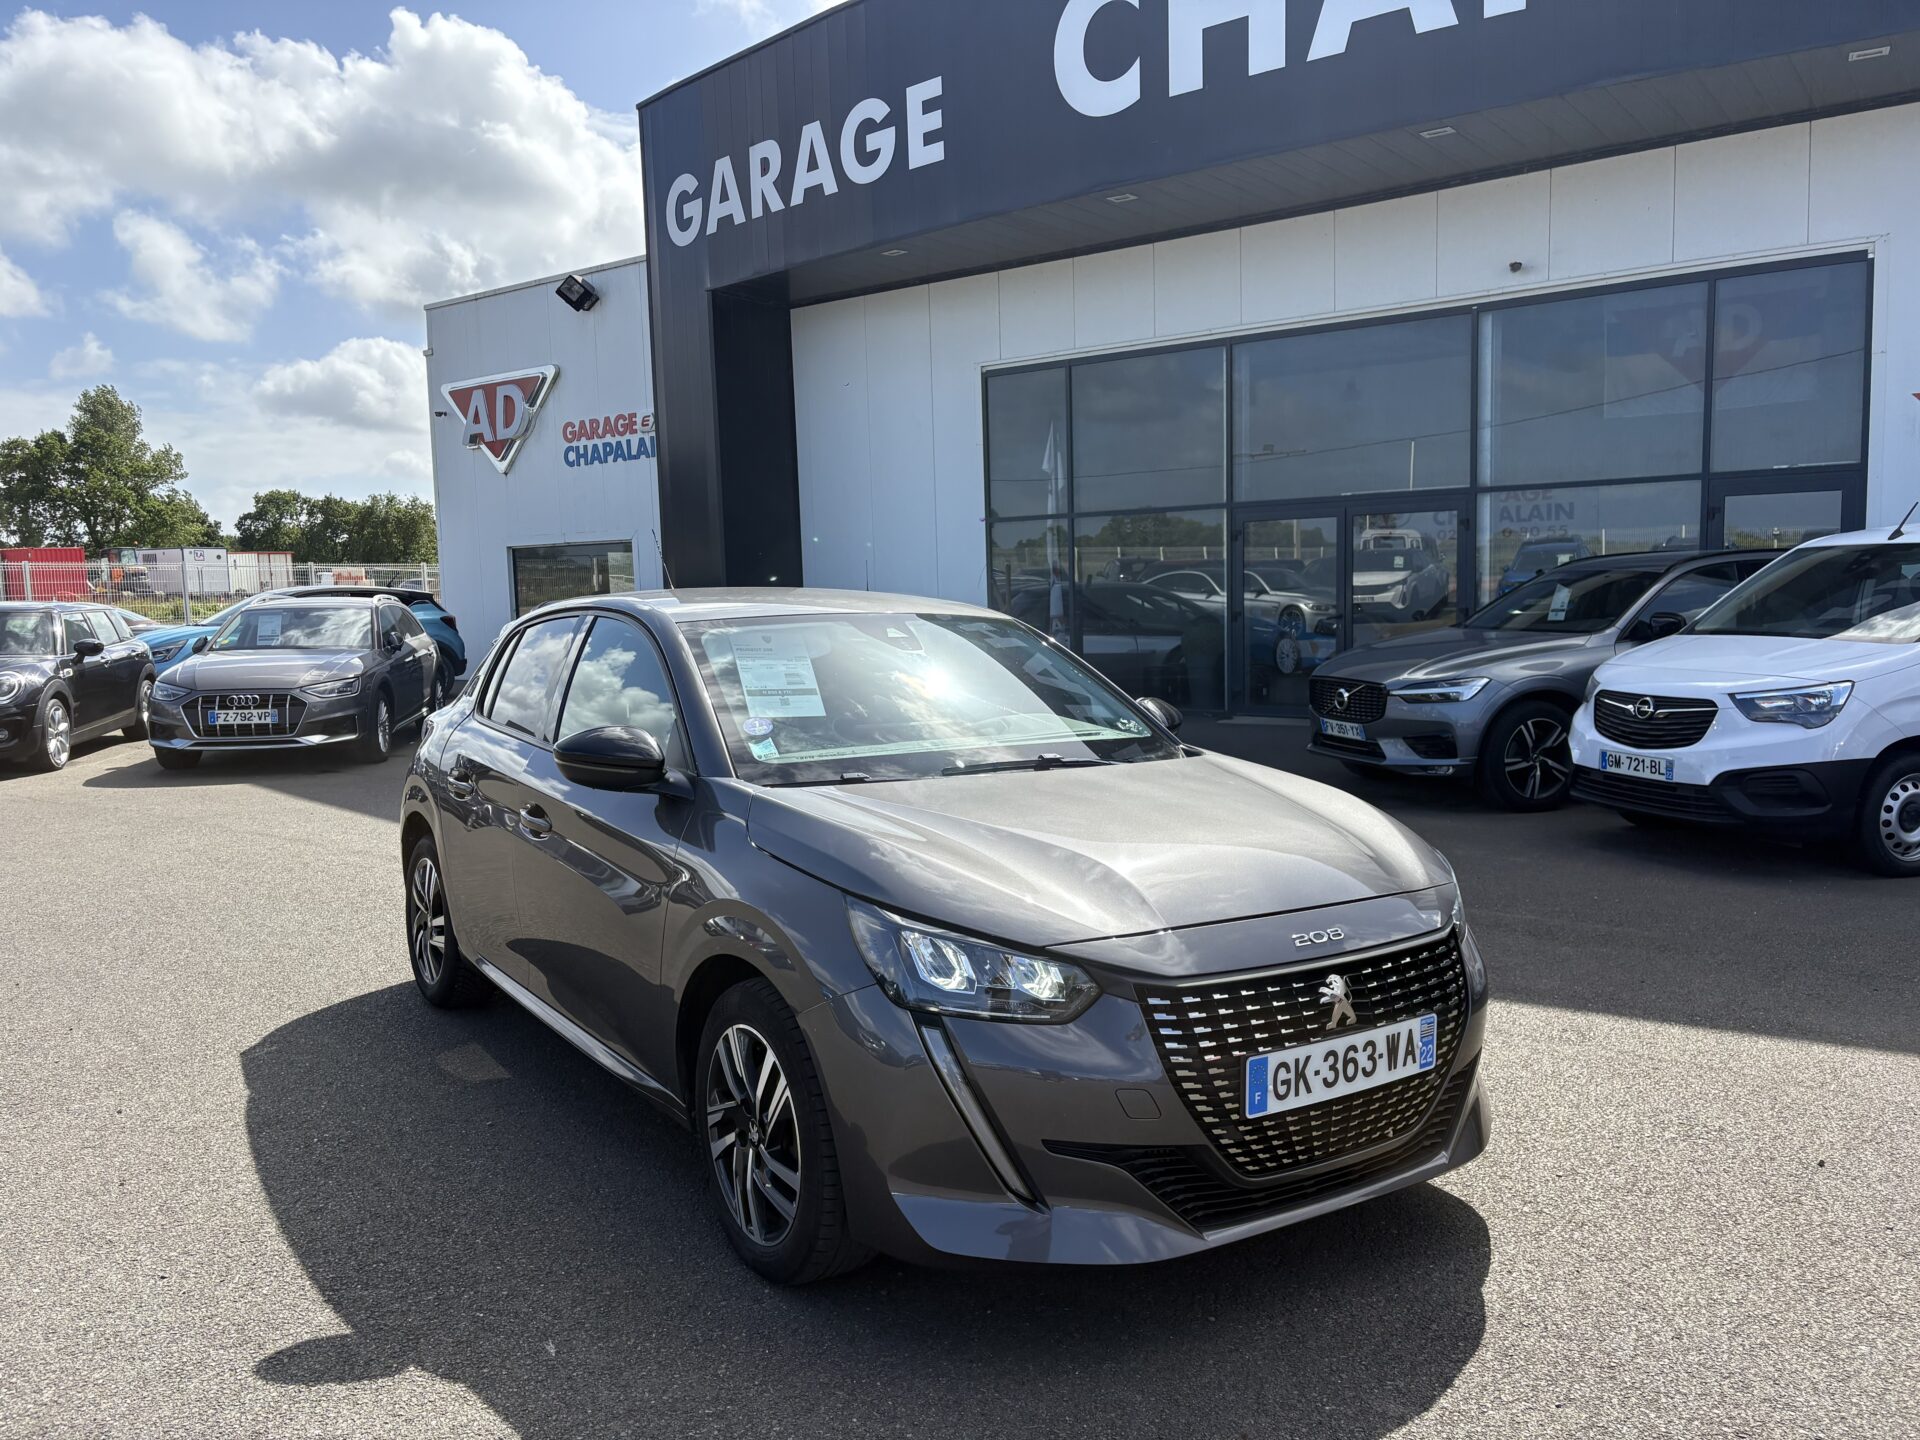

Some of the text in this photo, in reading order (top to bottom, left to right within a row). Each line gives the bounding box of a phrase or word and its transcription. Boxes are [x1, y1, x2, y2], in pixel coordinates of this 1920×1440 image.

[665, 75, 945, 248] GARAGE
[463, 384, 528, 446] AD
[562, 412, 638, 443] GARAGE
[563, 435, 656, 468] CHAPALAI
[215, 711, 271, 722] FZ-792-VP
[1607, 753, 1666, 776] GM-721-BL
[1292, 927, 1345, 947] 208
[1255, 1028, 1433, 1105] F GK-363-WA 22
